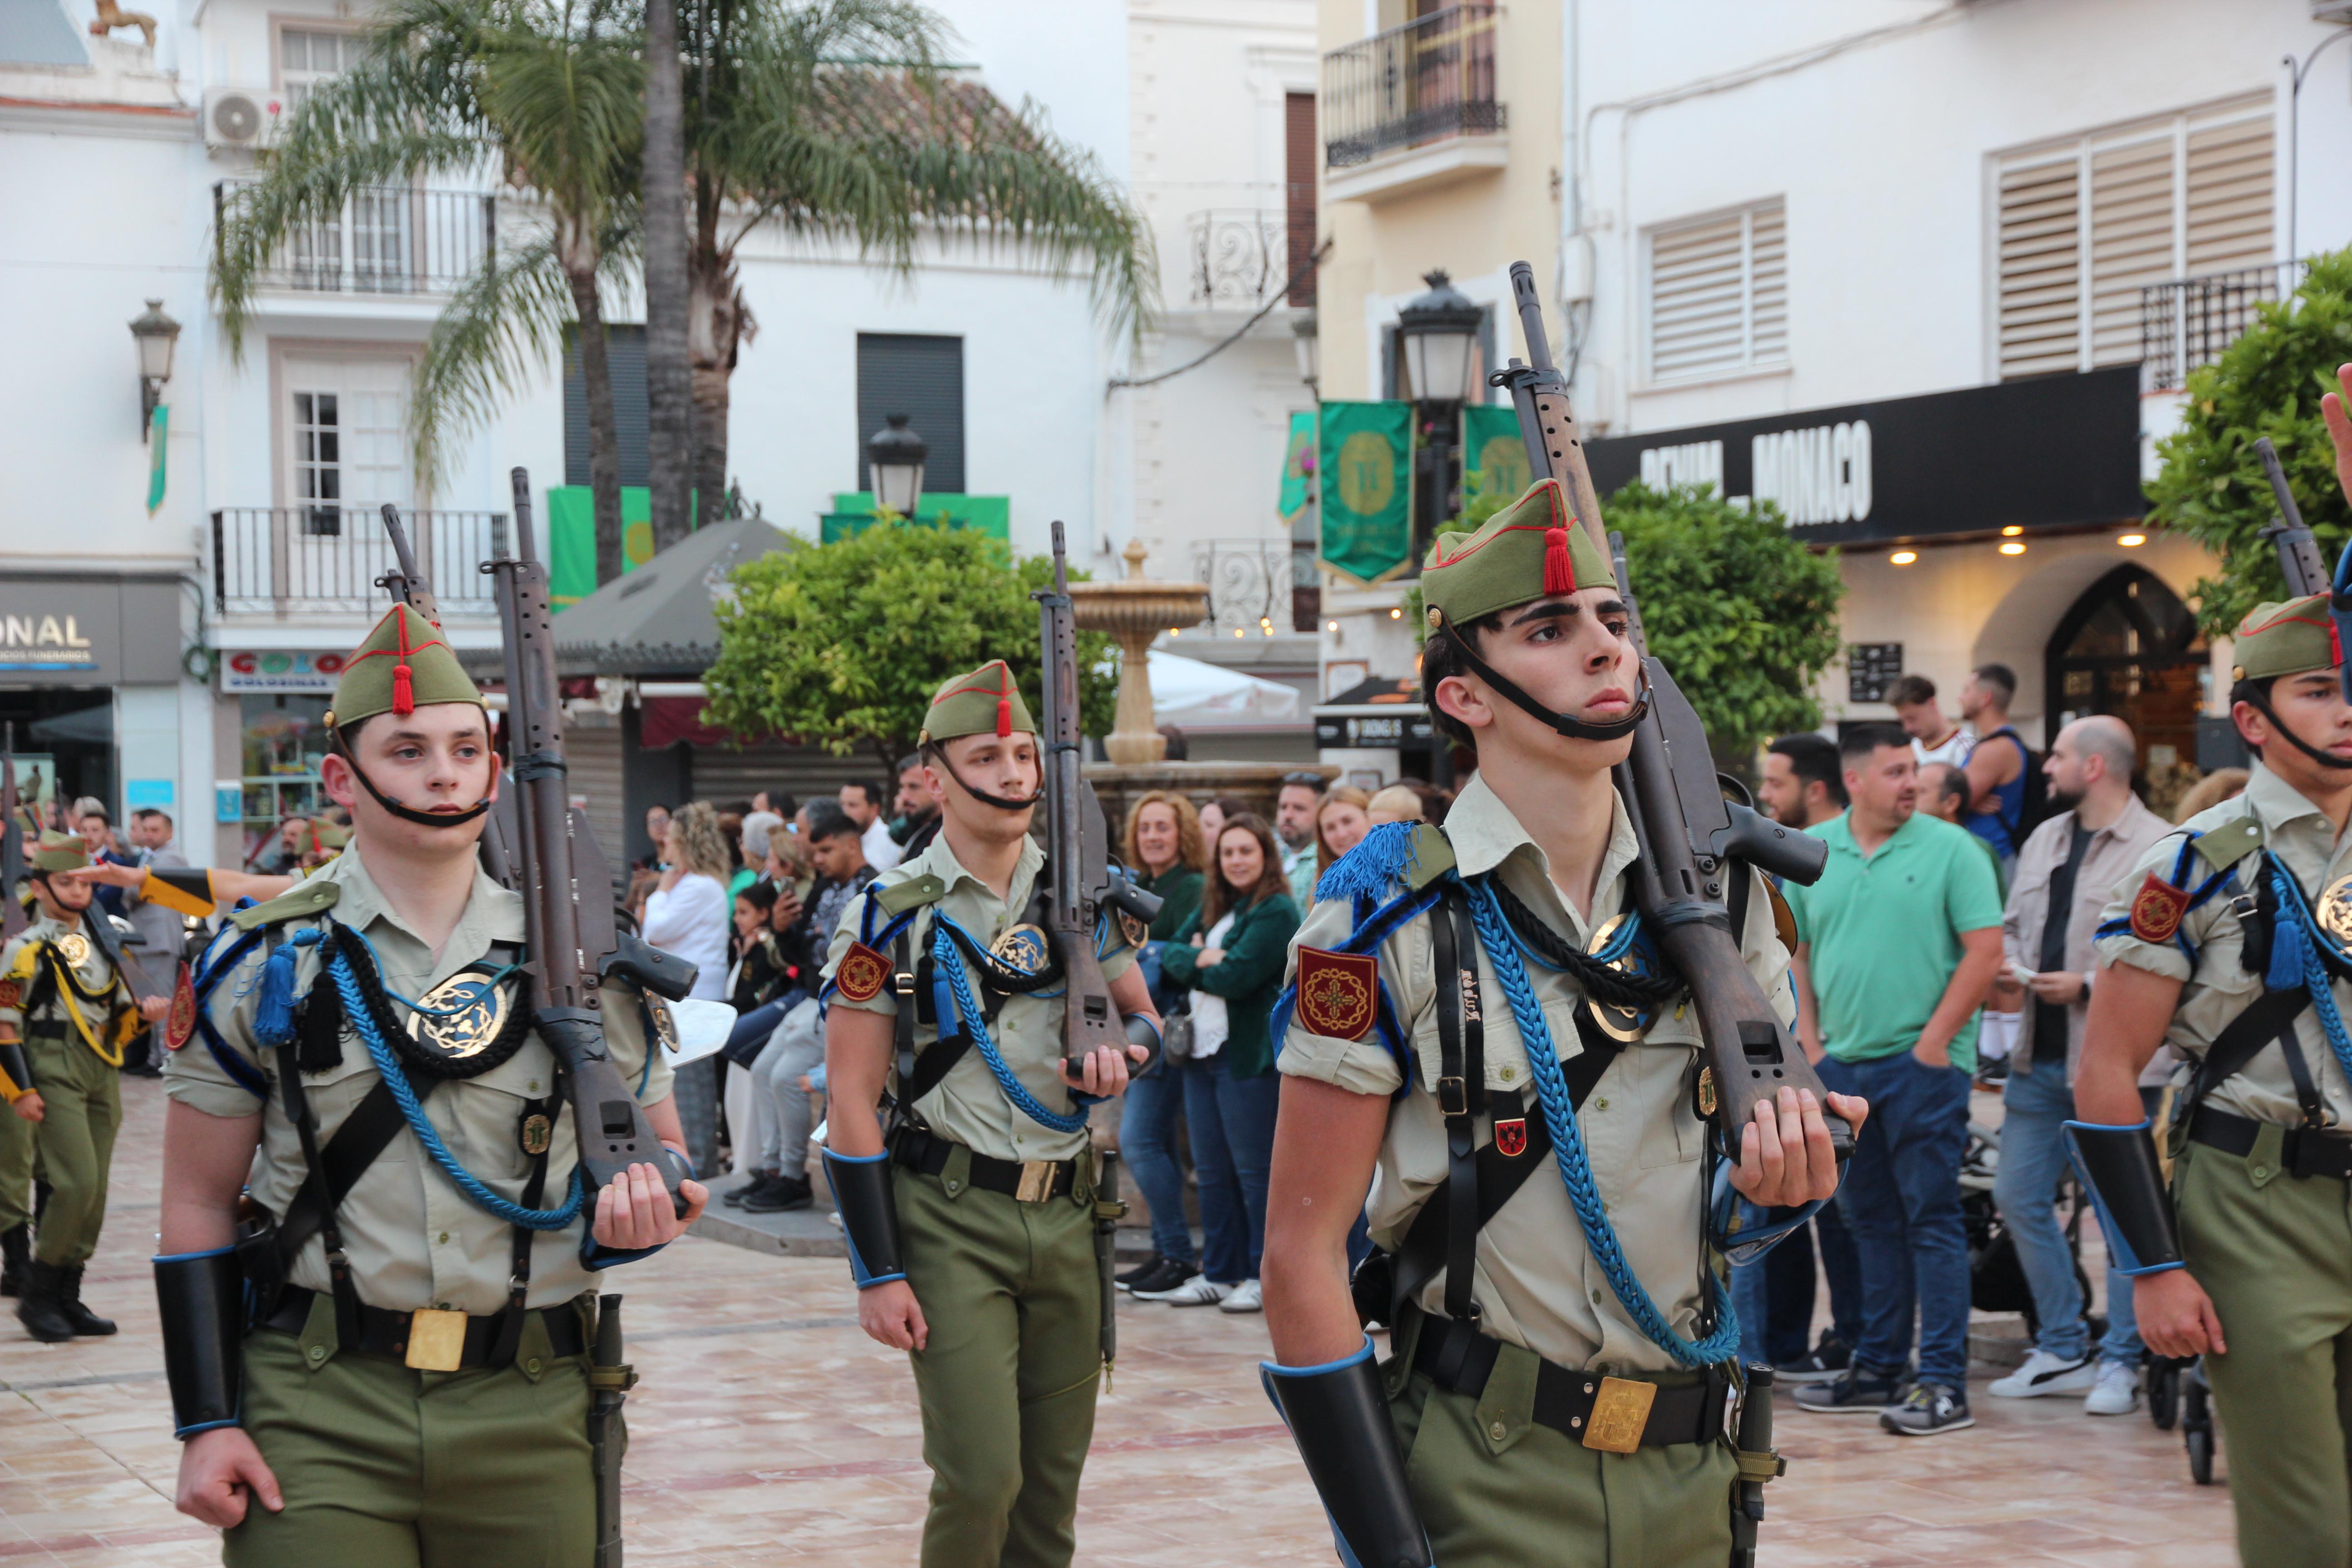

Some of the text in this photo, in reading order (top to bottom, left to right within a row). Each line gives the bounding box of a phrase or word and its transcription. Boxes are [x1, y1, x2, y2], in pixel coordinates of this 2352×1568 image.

[1752, 420, 1872, 529] MONACO
[0, 614, 92, 648] NAL
[28, 650, 91, 662] FUNERARIOS
